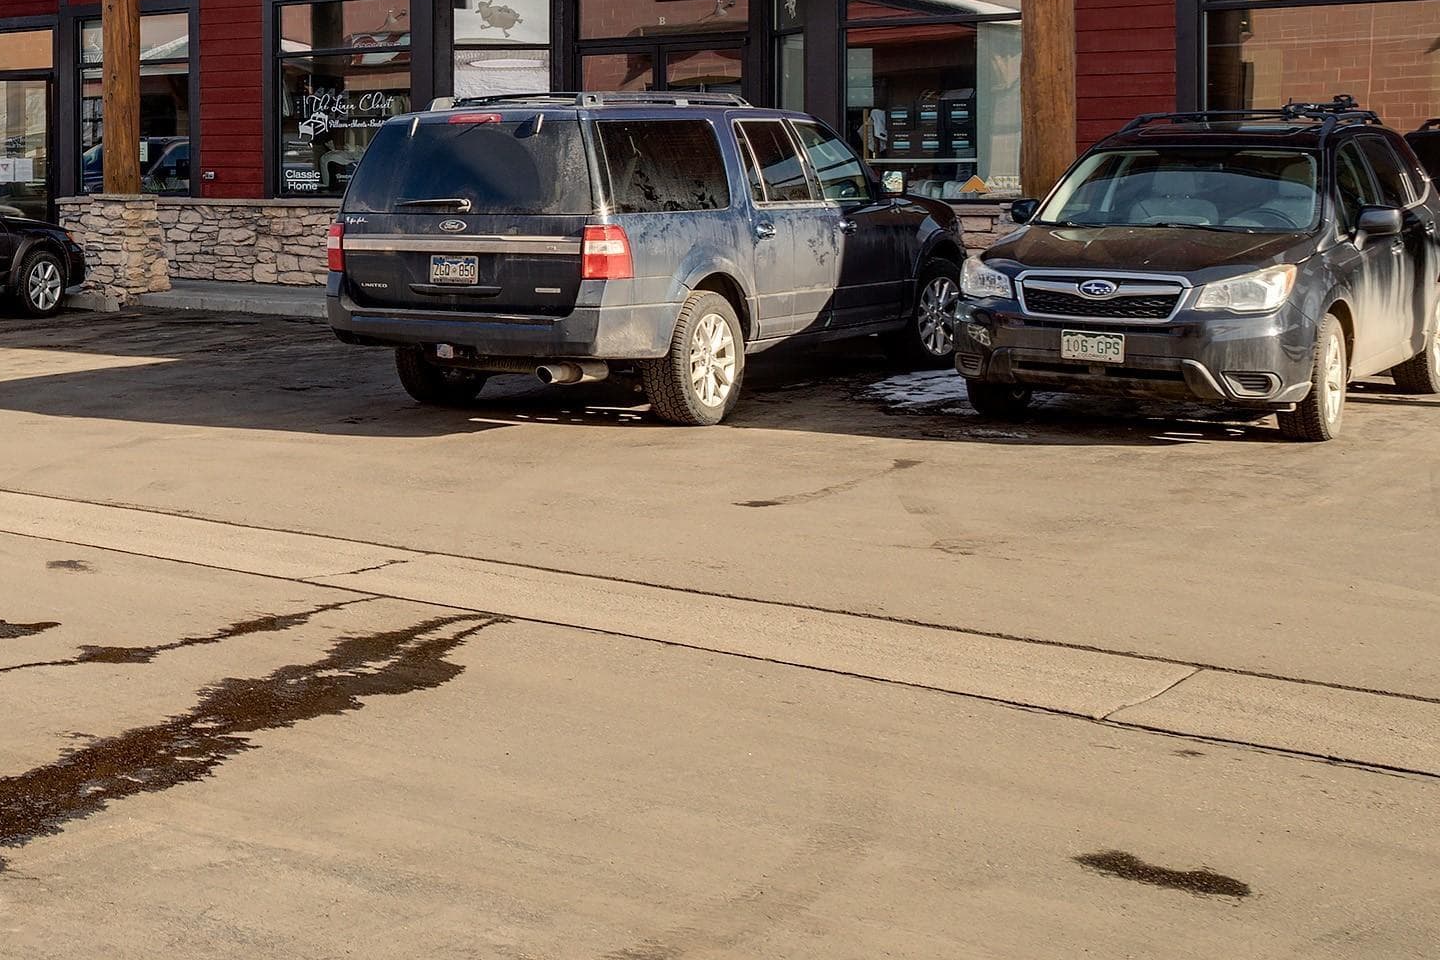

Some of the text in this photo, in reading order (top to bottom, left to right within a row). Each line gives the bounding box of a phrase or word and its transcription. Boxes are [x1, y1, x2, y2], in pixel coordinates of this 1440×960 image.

[306, 91, 394, 114] The Linen Closet
[285, 169, 320, 179] Classic
[288, 181, 318, 190] Home
